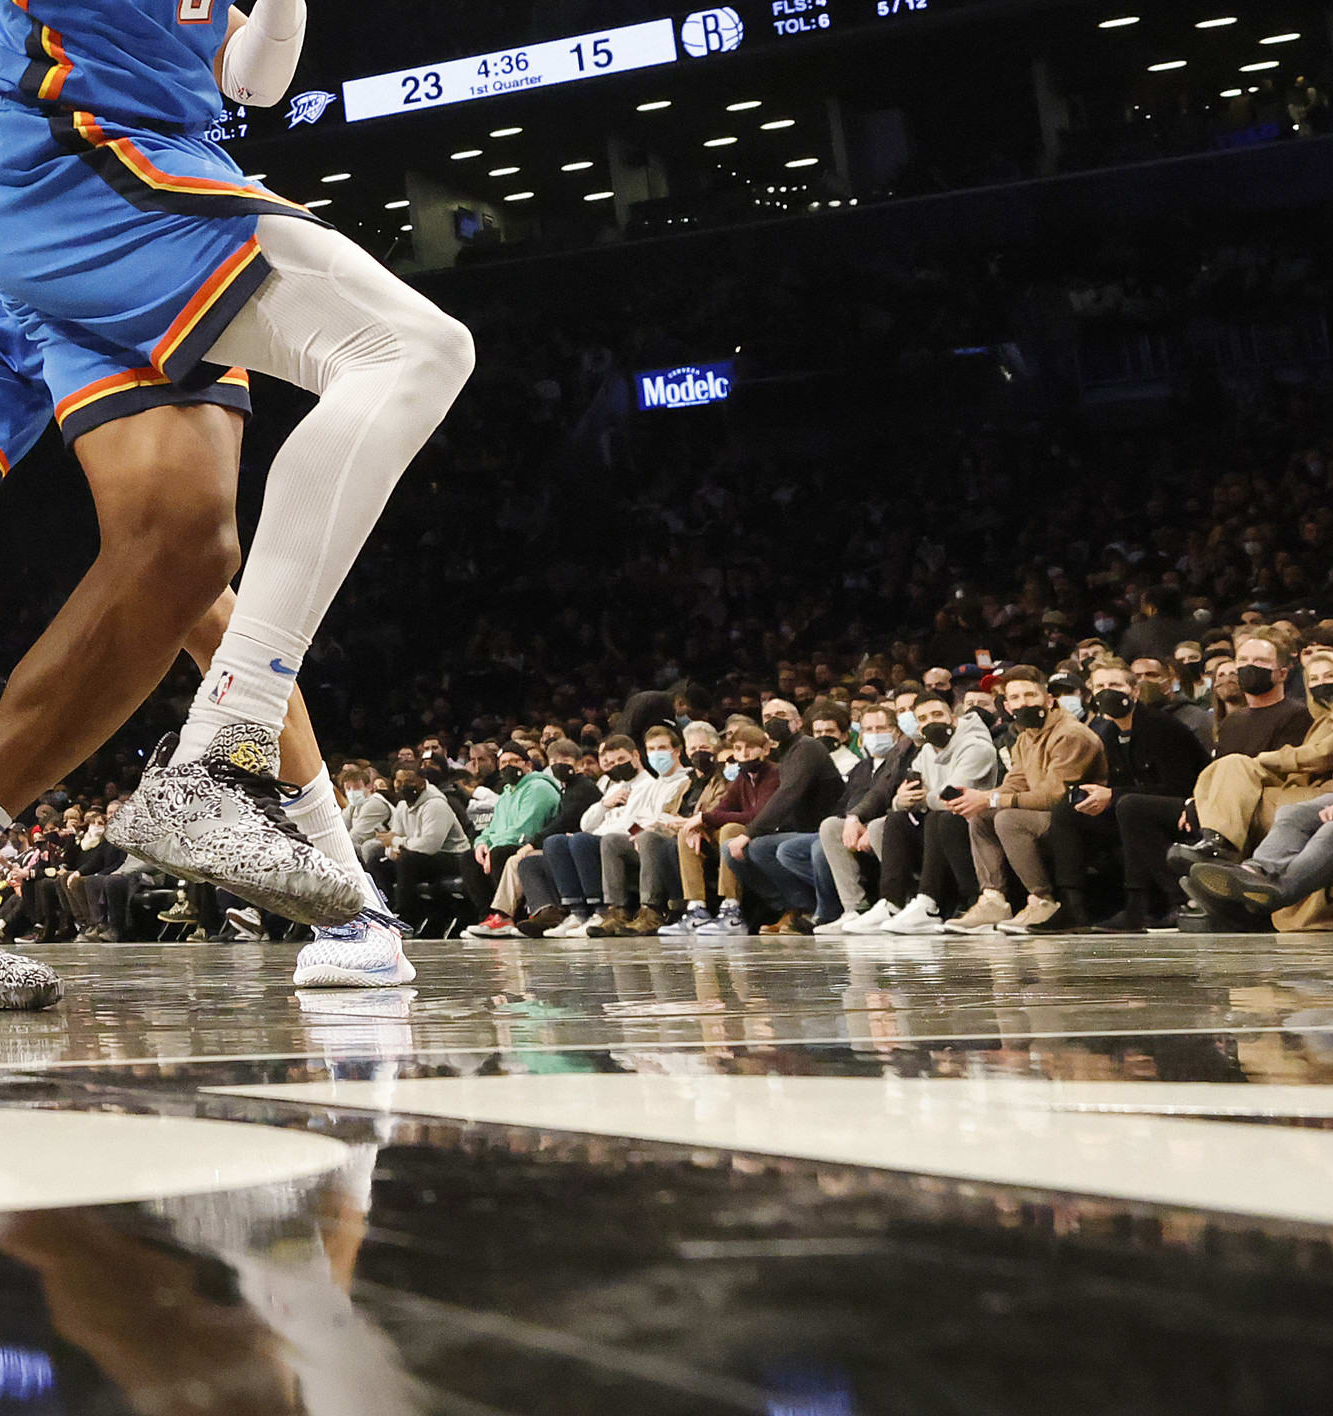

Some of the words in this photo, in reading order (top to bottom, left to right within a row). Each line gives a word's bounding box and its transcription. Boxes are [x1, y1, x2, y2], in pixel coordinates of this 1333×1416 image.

[401, 71, 444, 106] 23
[477, 51, 529, 80] 4:36
[569, 38, 614, 73] 15
[468, 84, 489, 97] 1st
[492, 73, 543, 93] Quarter
[642, 370, 729, 407] Modelo
